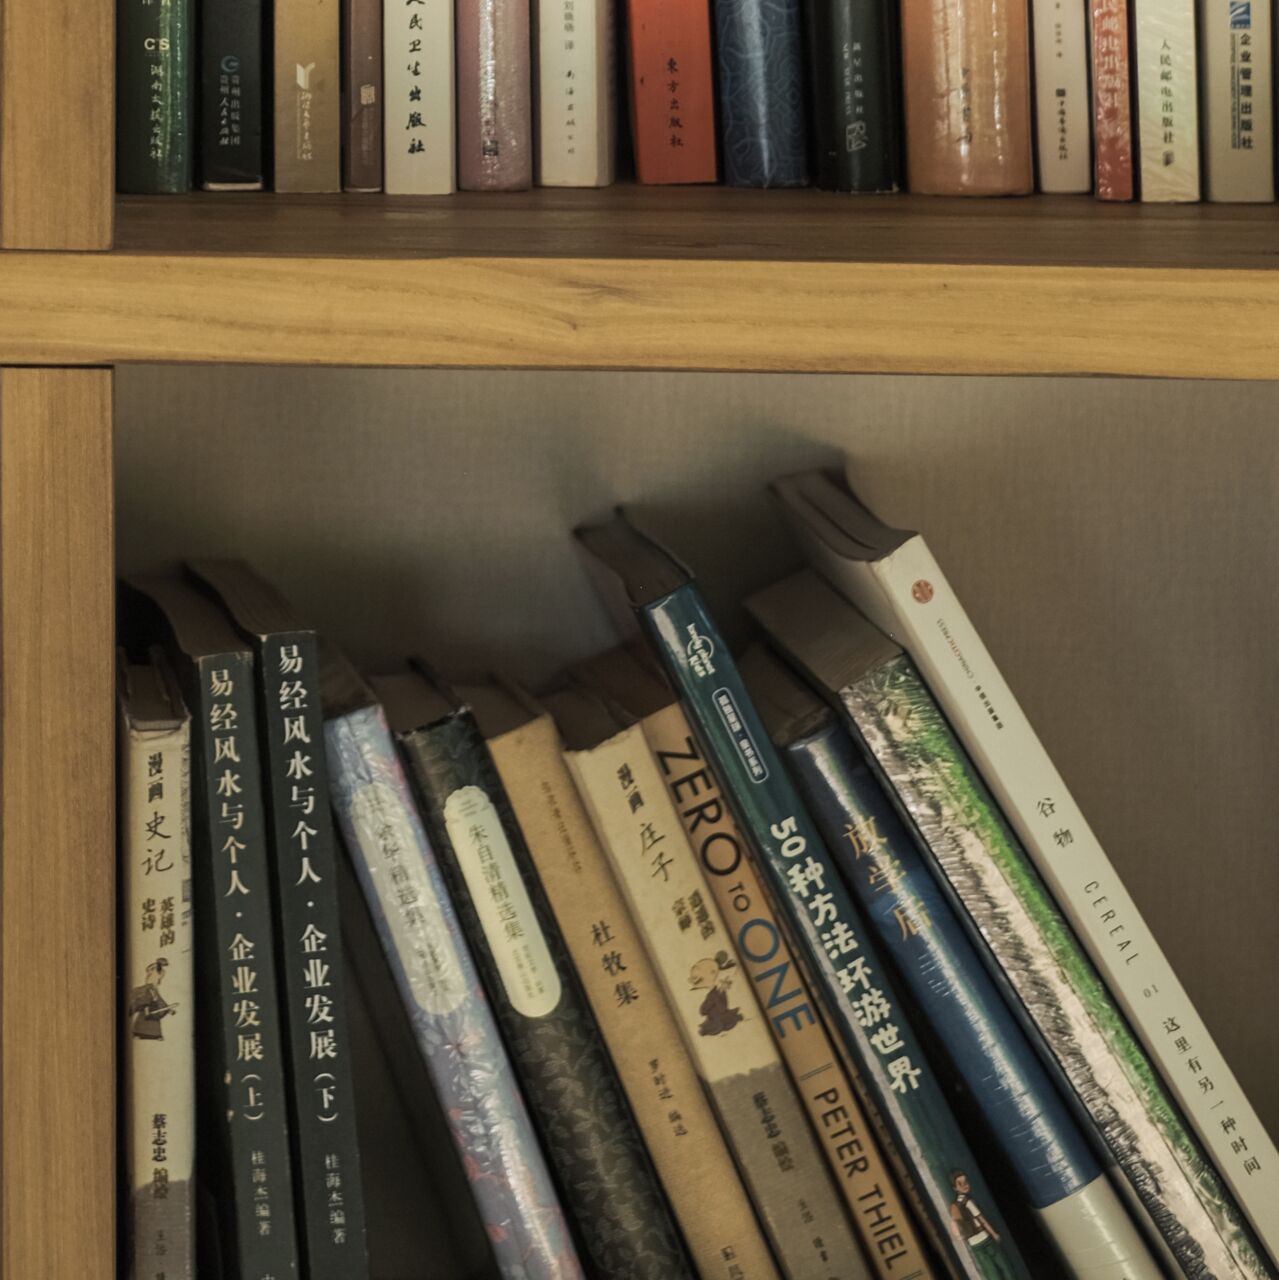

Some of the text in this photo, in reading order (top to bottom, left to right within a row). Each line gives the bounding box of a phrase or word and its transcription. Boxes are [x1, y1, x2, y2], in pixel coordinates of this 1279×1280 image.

[1240, 33, 1254, 151] 企业管理出版社
[140, 810, 174, 876] 史记
[655, 735, 743, 877] ZERO
[1037, 796, 1074, 849] 谷物
[728, 881, 751, 913] TO
[769, 815, 922, 1094] 50种方法环游世界
[1083, 879, 1141, 966] CEREAL
[590, 921, 640, 1008] 杜牧集
[738, 917, 816, 1039] ONE
[1163, 1015, 1262, 1177] 这里有另一种时间
[813, 1086, 908, 1270] PETER THIEL
